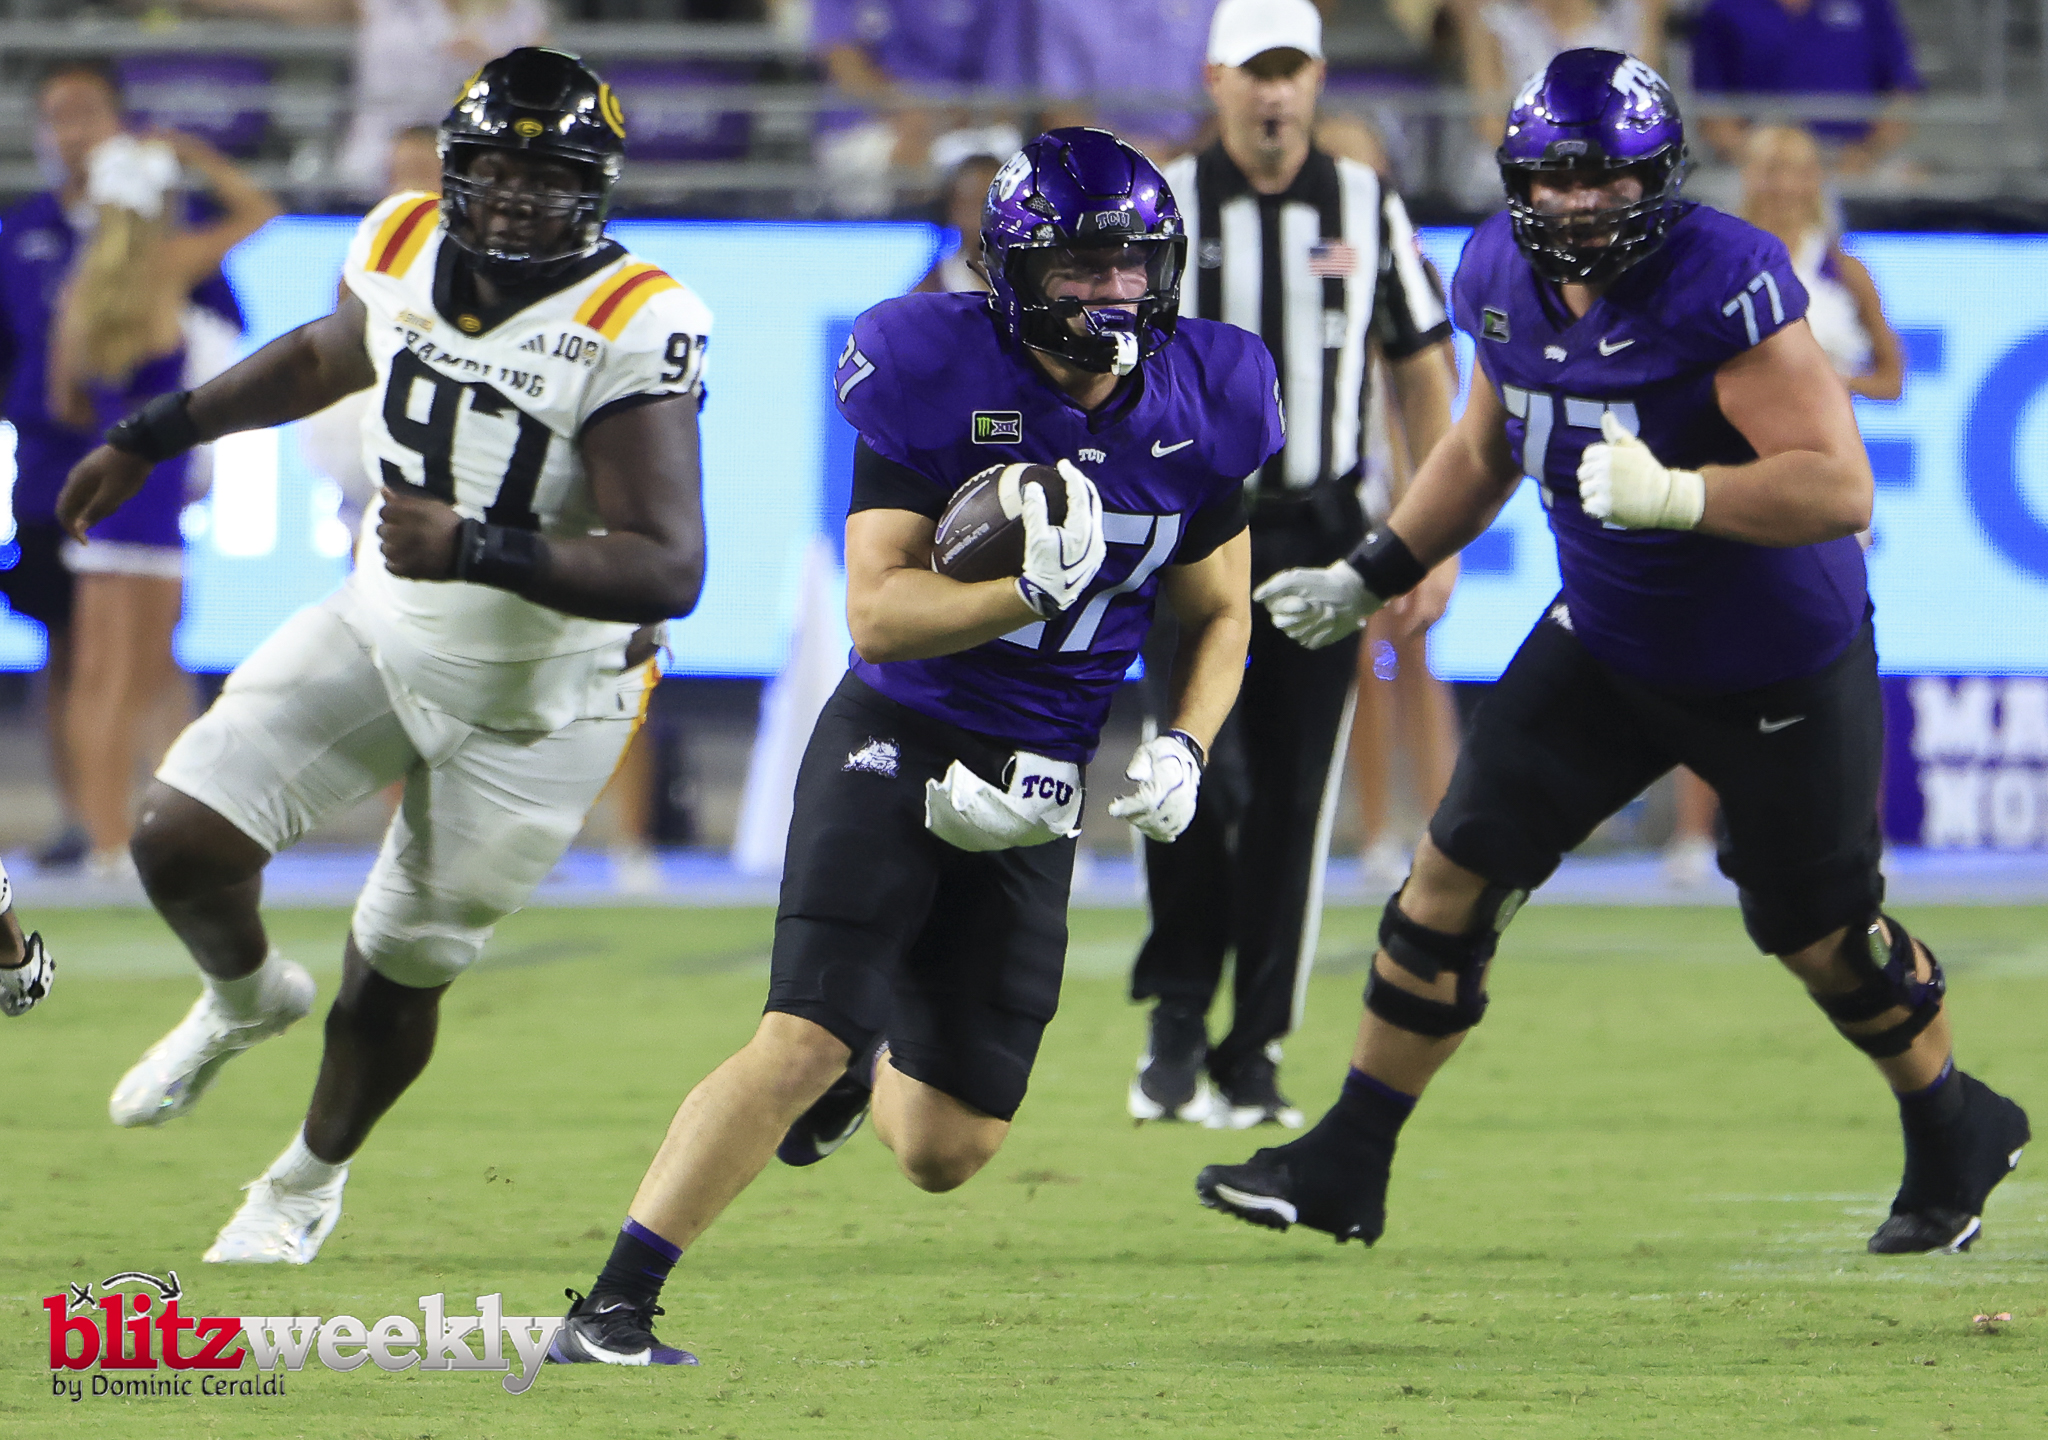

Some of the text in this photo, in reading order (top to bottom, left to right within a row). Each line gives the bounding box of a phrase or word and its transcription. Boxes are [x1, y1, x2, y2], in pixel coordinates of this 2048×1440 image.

[1096, 211, 1131, 230] TCU
[1722, 270, 1785, 346] 77
[380, 346, 553, 529] 97
[1078, 448, 1106, 464] TCU
[1022, 774, 1074, 807] TCU
